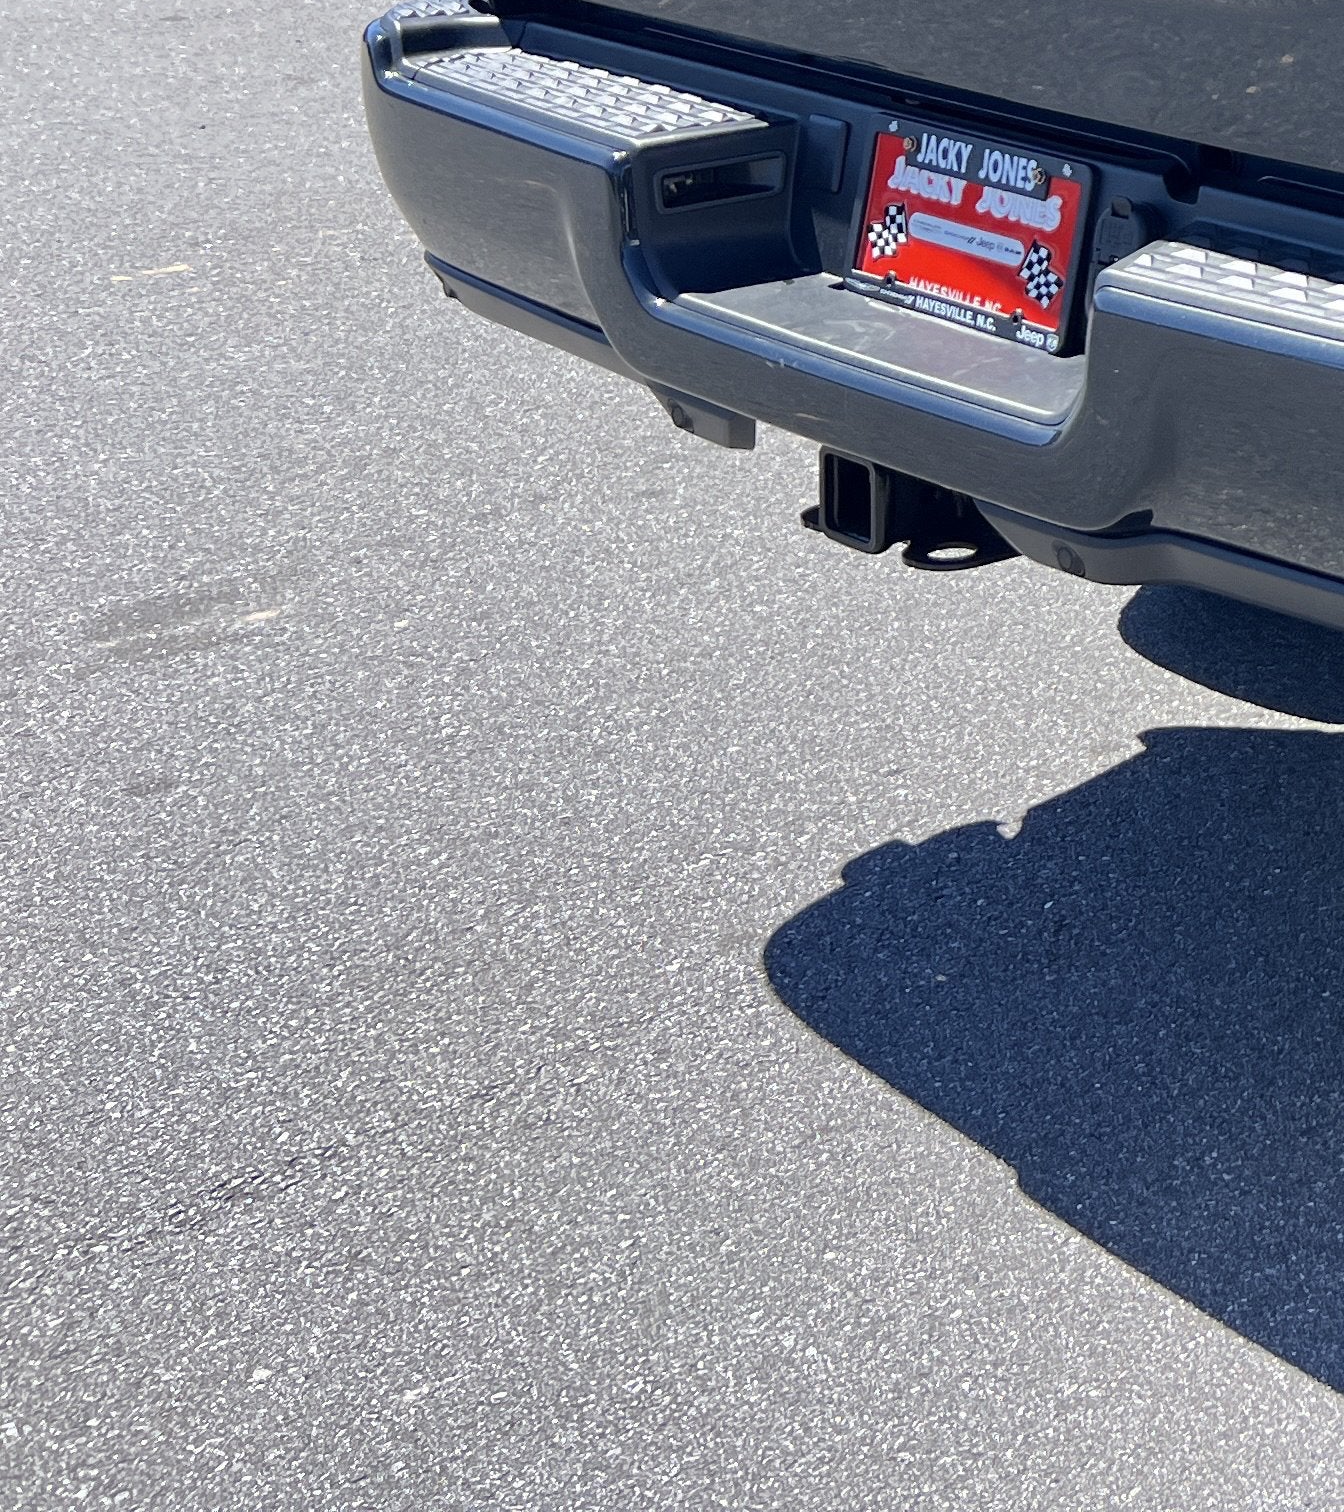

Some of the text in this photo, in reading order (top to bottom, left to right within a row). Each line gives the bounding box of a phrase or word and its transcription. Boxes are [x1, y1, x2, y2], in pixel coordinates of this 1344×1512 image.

[916, 133, 1039, 191] JACKY JONES
[887, 155, 1063, 232] JACKY JONES
[1015, 325, 1045, 348] Jeep
